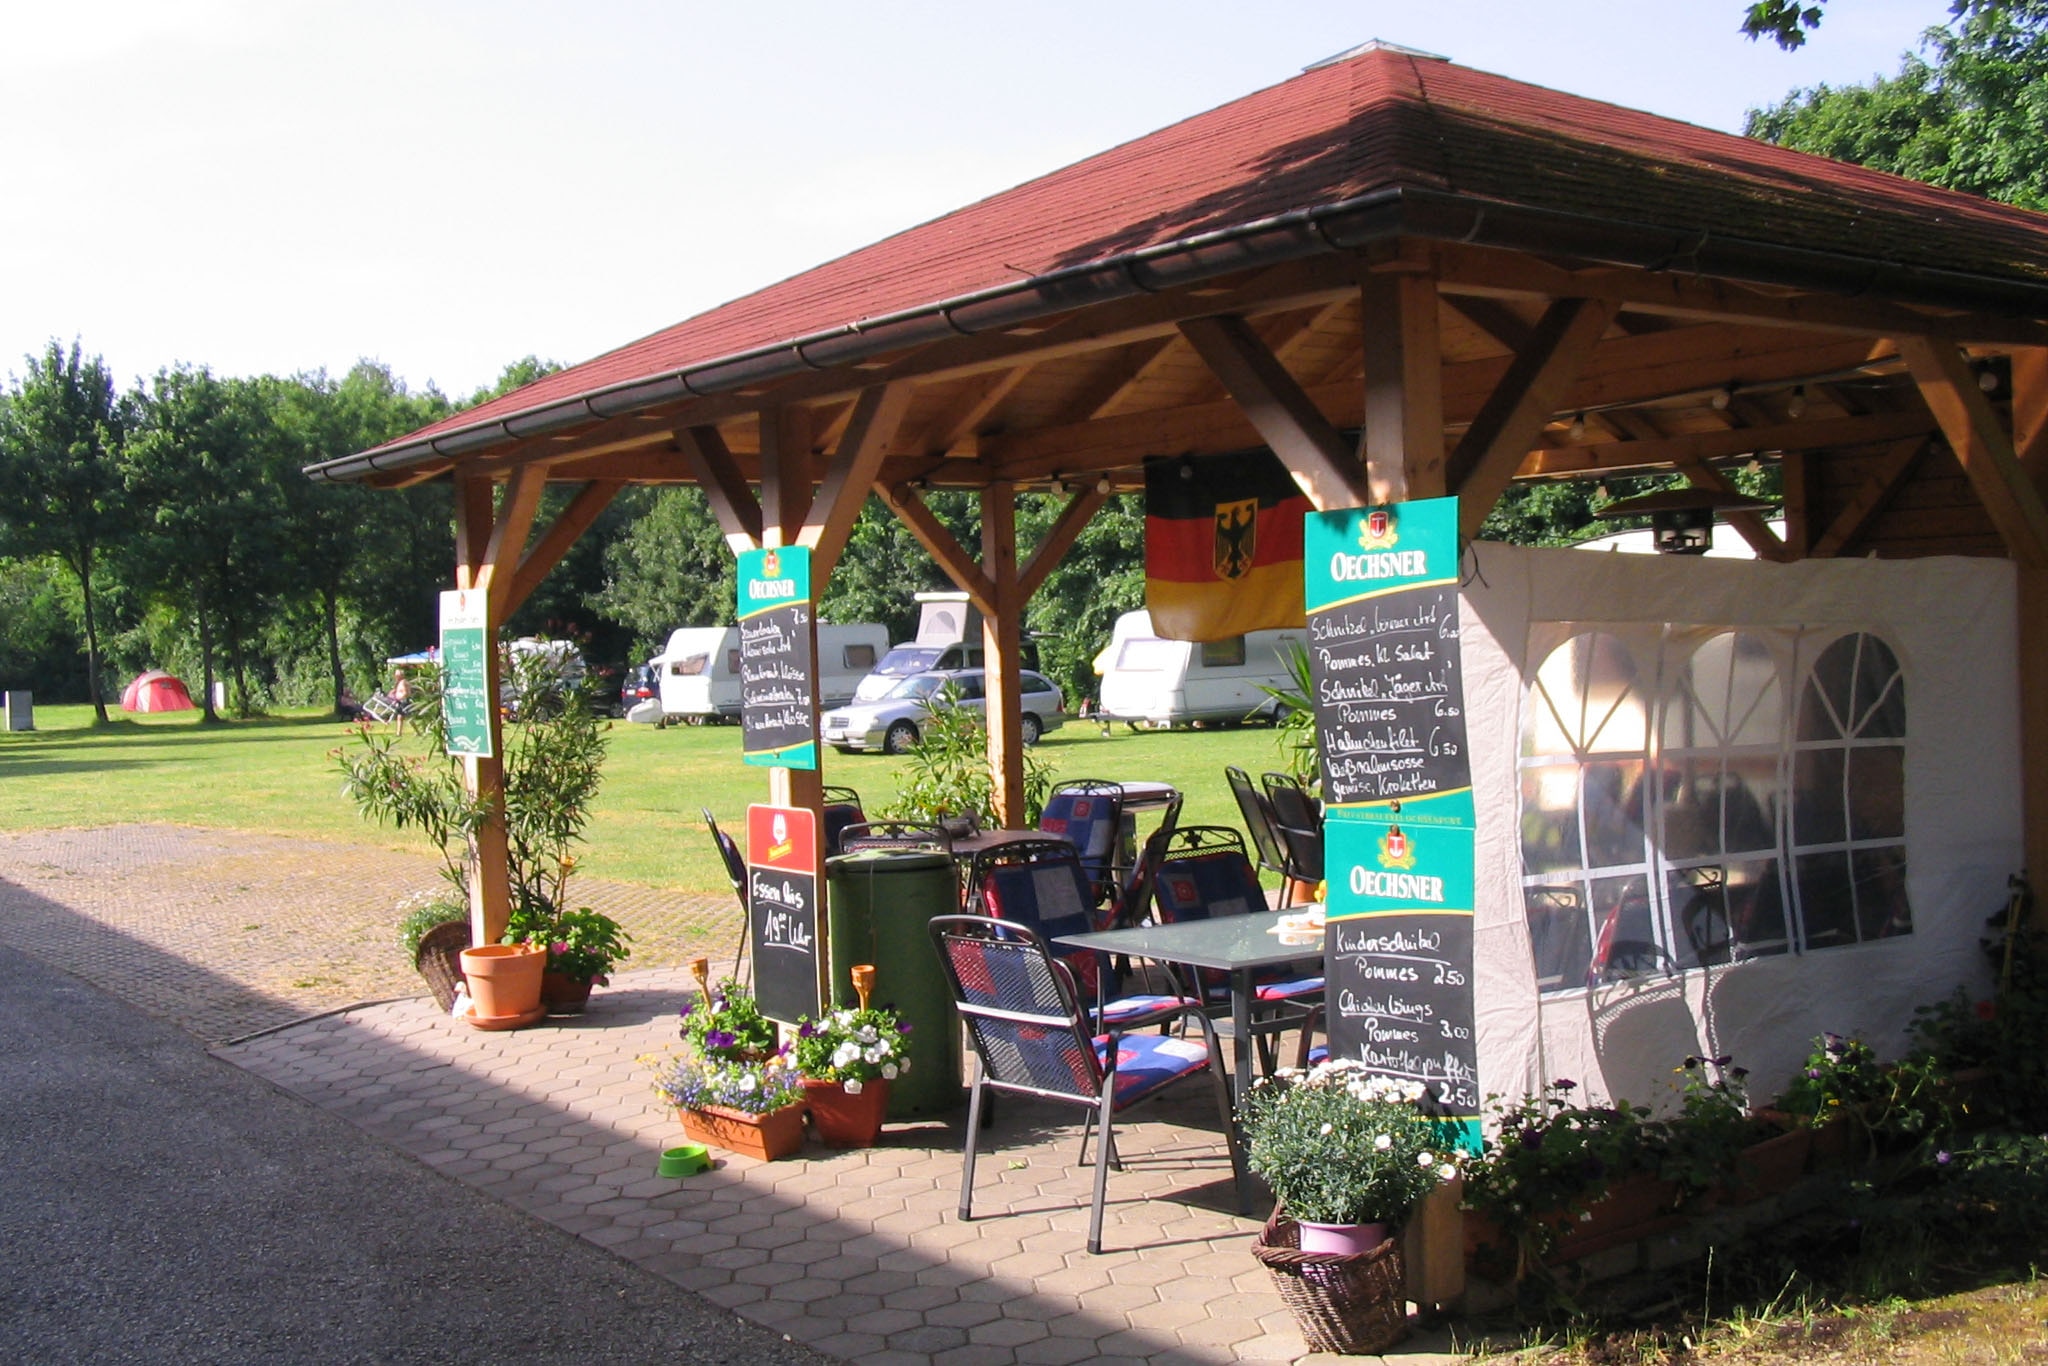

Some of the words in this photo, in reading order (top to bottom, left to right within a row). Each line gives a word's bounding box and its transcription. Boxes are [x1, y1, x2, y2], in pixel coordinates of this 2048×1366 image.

[1331, 550, 1427, 582] OECHSNER
[748, 578, 795, 600] OECHSNER
[1311, 615, 1367, 641] Schnitzel
[1395, 640, 1434, 662] Salat
[1338, 703, 1397, 724] Pommes
[1377, 771, 1437, 797] Kroketten
[752, 871, 781, 901] Essen
[783, 880, 804, 909] bis
[1349, 864, 1444, 903] OECHSNER
[788, 915, 812, 947] Uhr
[1355, 956, 1419, 982] Pommes
[1364, 1017, 1419, 1043] Pommes
